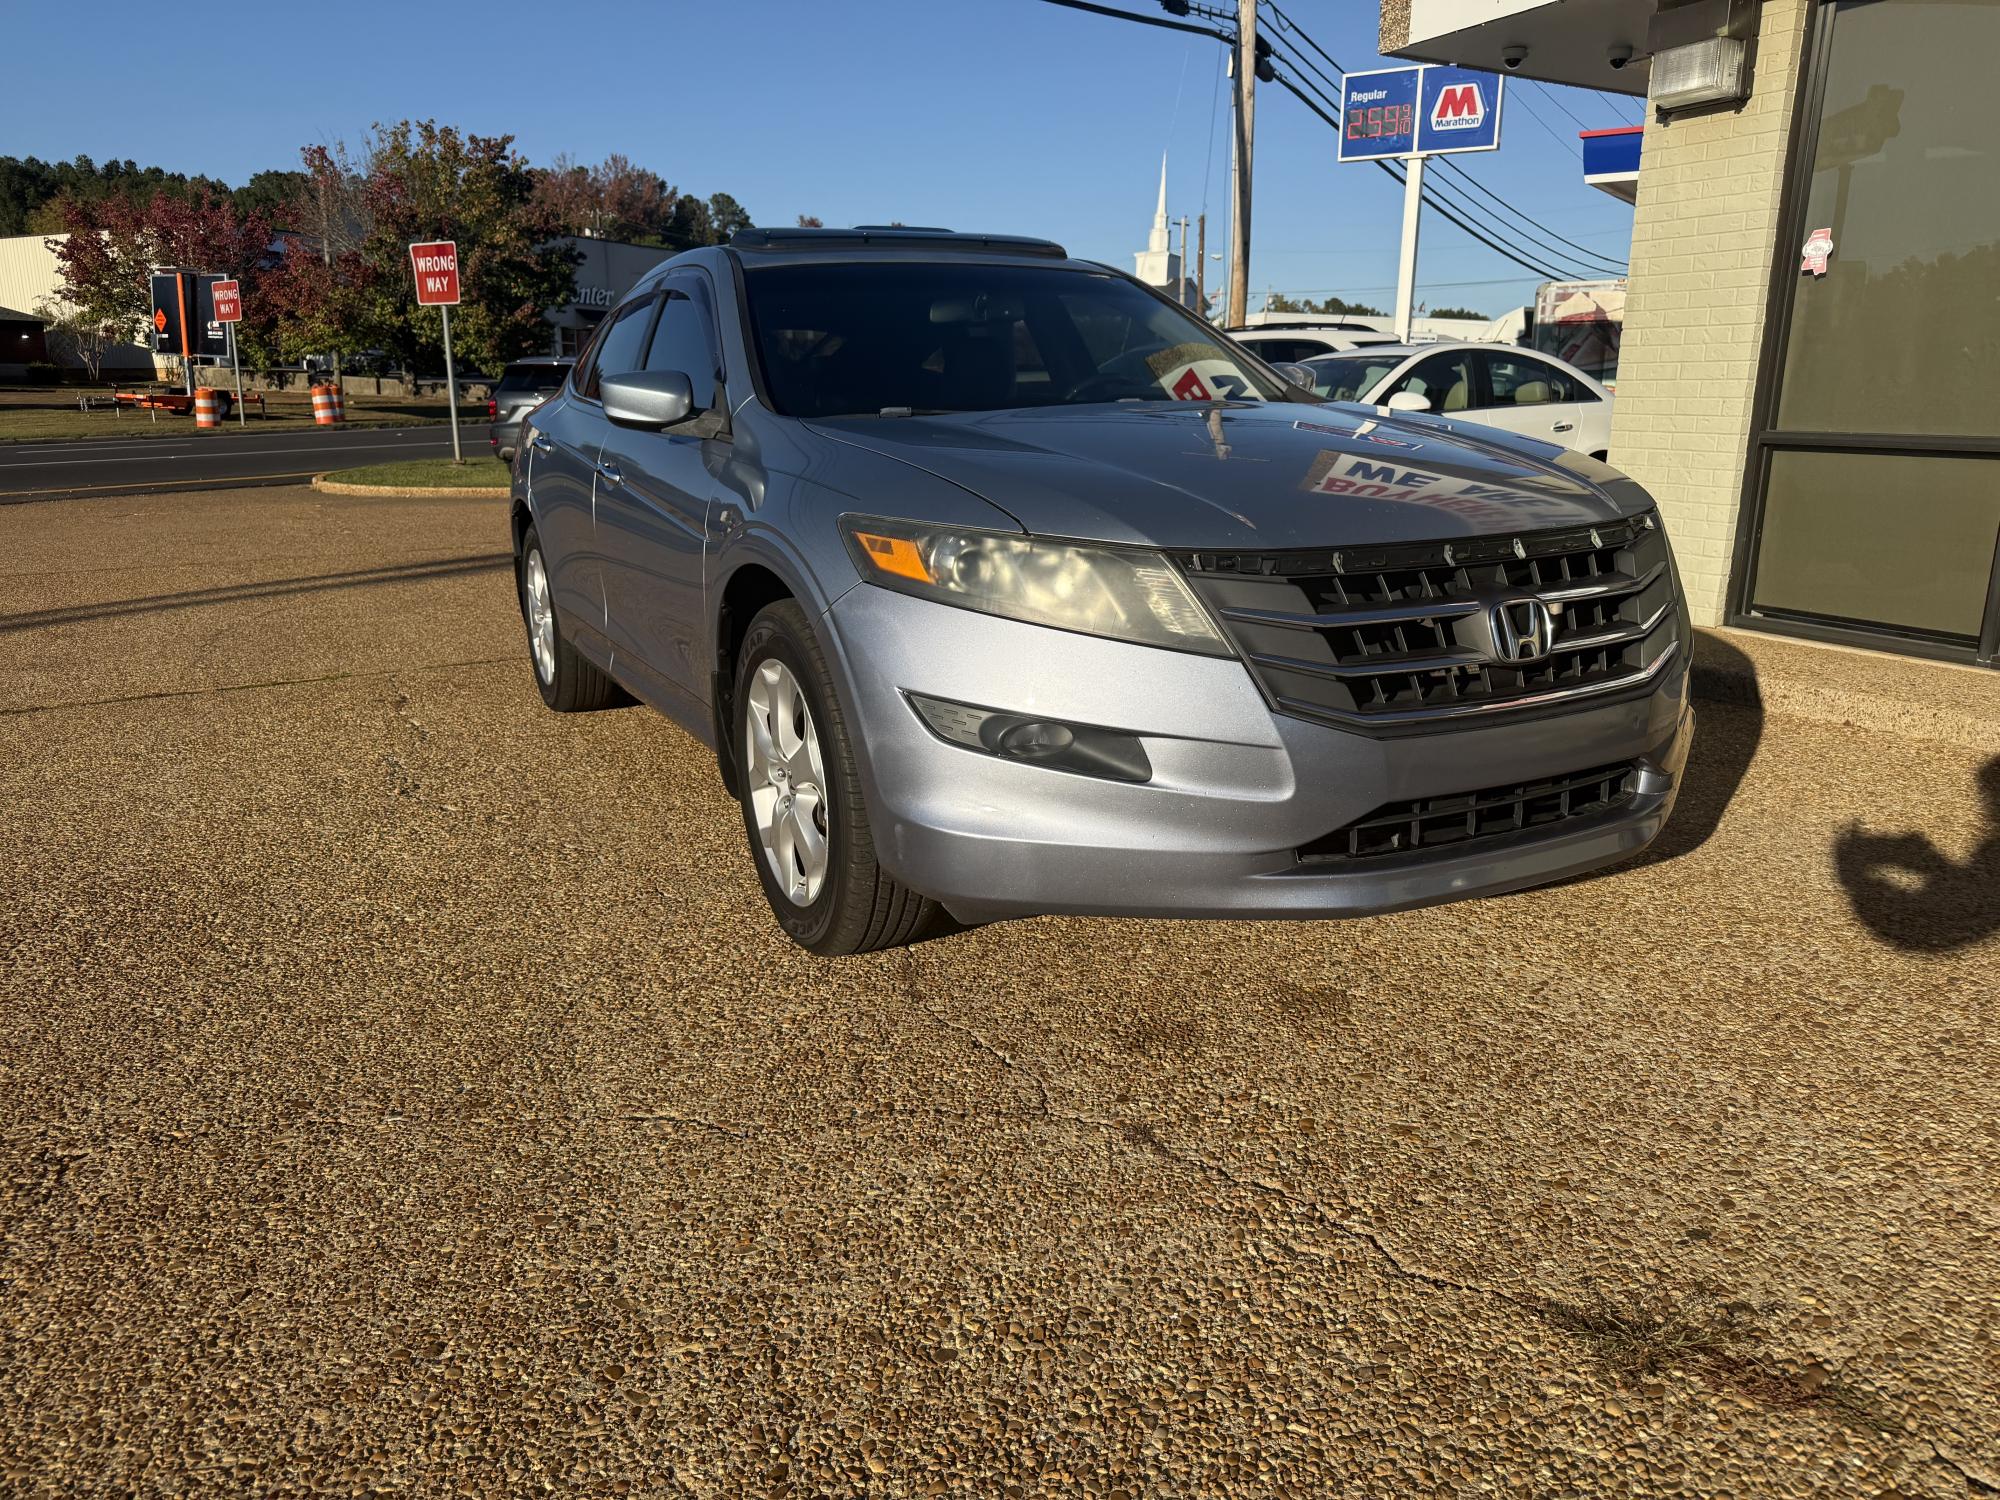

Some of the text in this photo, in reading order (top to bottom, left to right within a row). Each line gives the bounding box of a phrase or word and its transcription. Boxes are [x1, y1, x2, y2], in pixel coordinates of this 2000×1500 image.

[1351, 90, 1387, 102] Regular
[1347, 106, 1400, 139] 2.59
[1434, 117, 1479, 128] Marathon
[416, 255, 455, 272] WRONG
[426, 276, 449, 293] WAY
[214, 289, 238, 301] WRONG
[219, 303, 234, 314] WAY
